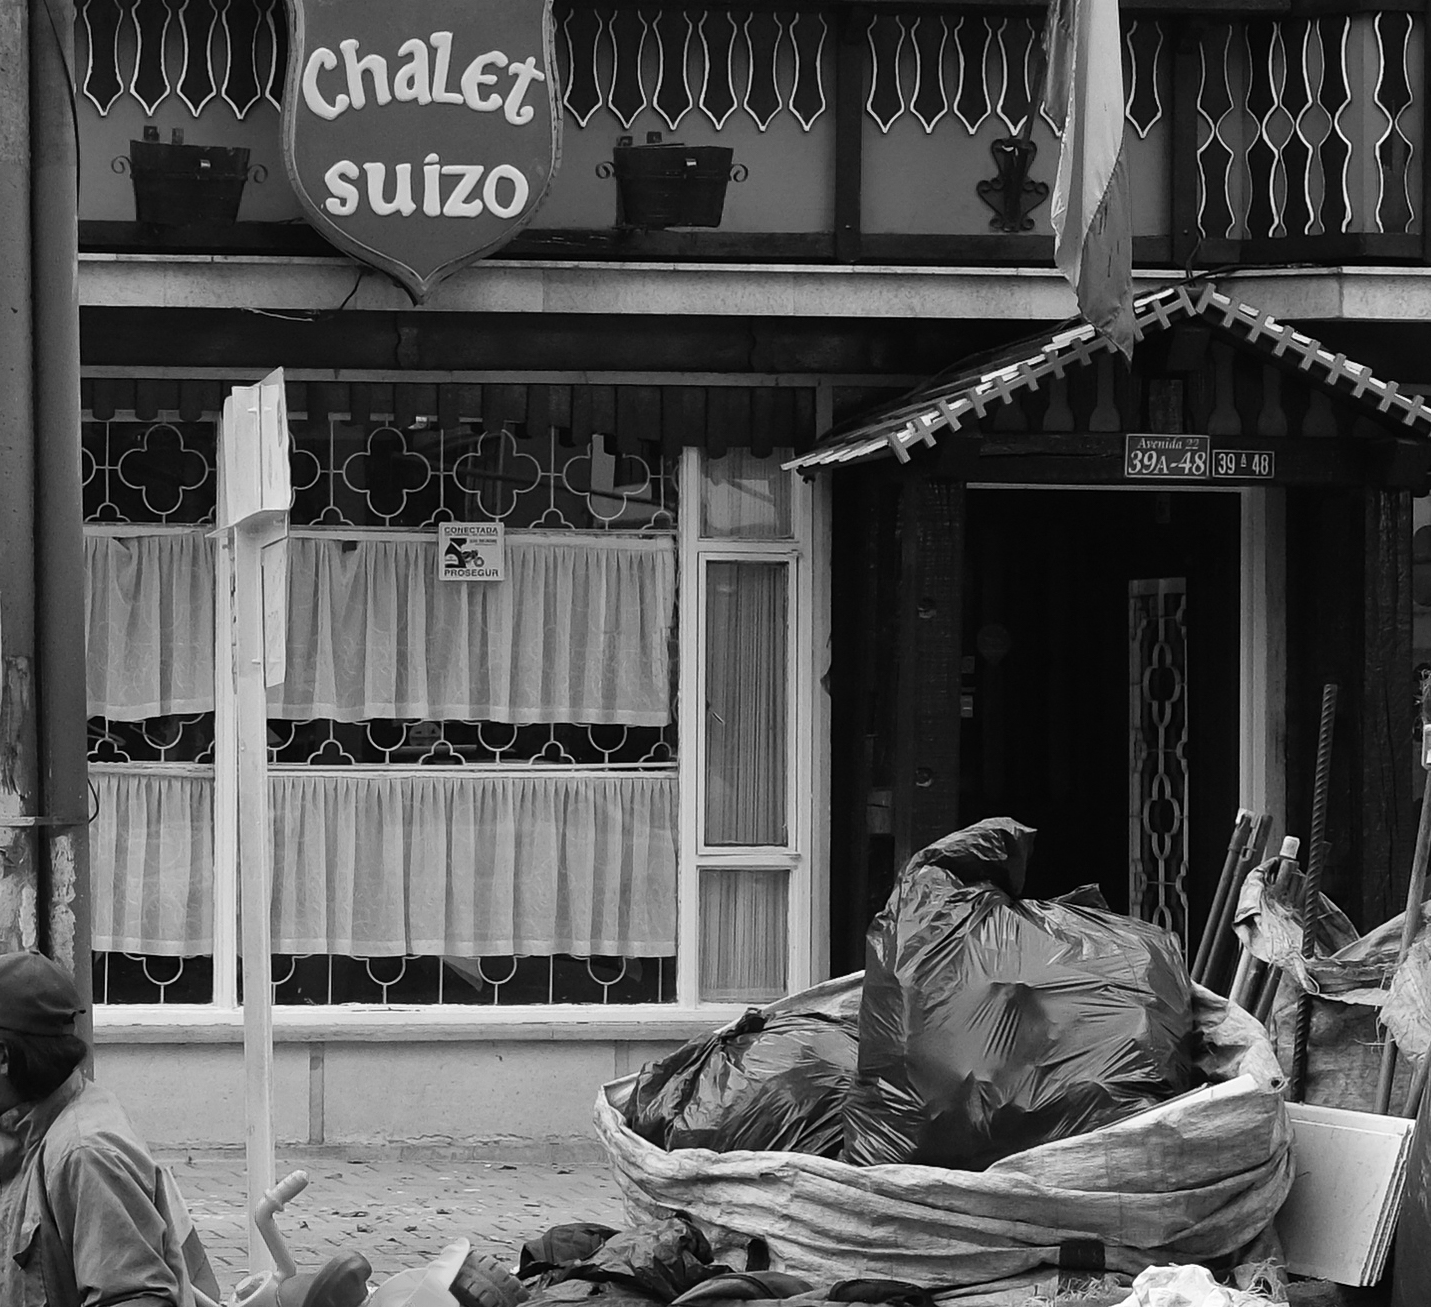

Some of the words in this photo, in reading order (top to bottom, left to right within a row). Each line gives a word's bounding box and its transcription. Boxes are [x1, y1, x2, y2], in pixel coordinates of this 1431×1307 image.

[1137, 437, 1183, 450] Avenida
[1218, 453, 1235, 474] 39
[1252, 454, 1269, 475] 48
[444, 526, 498, 534] CONECTADA
[444, 569, 499, 577] PROSEGUR
